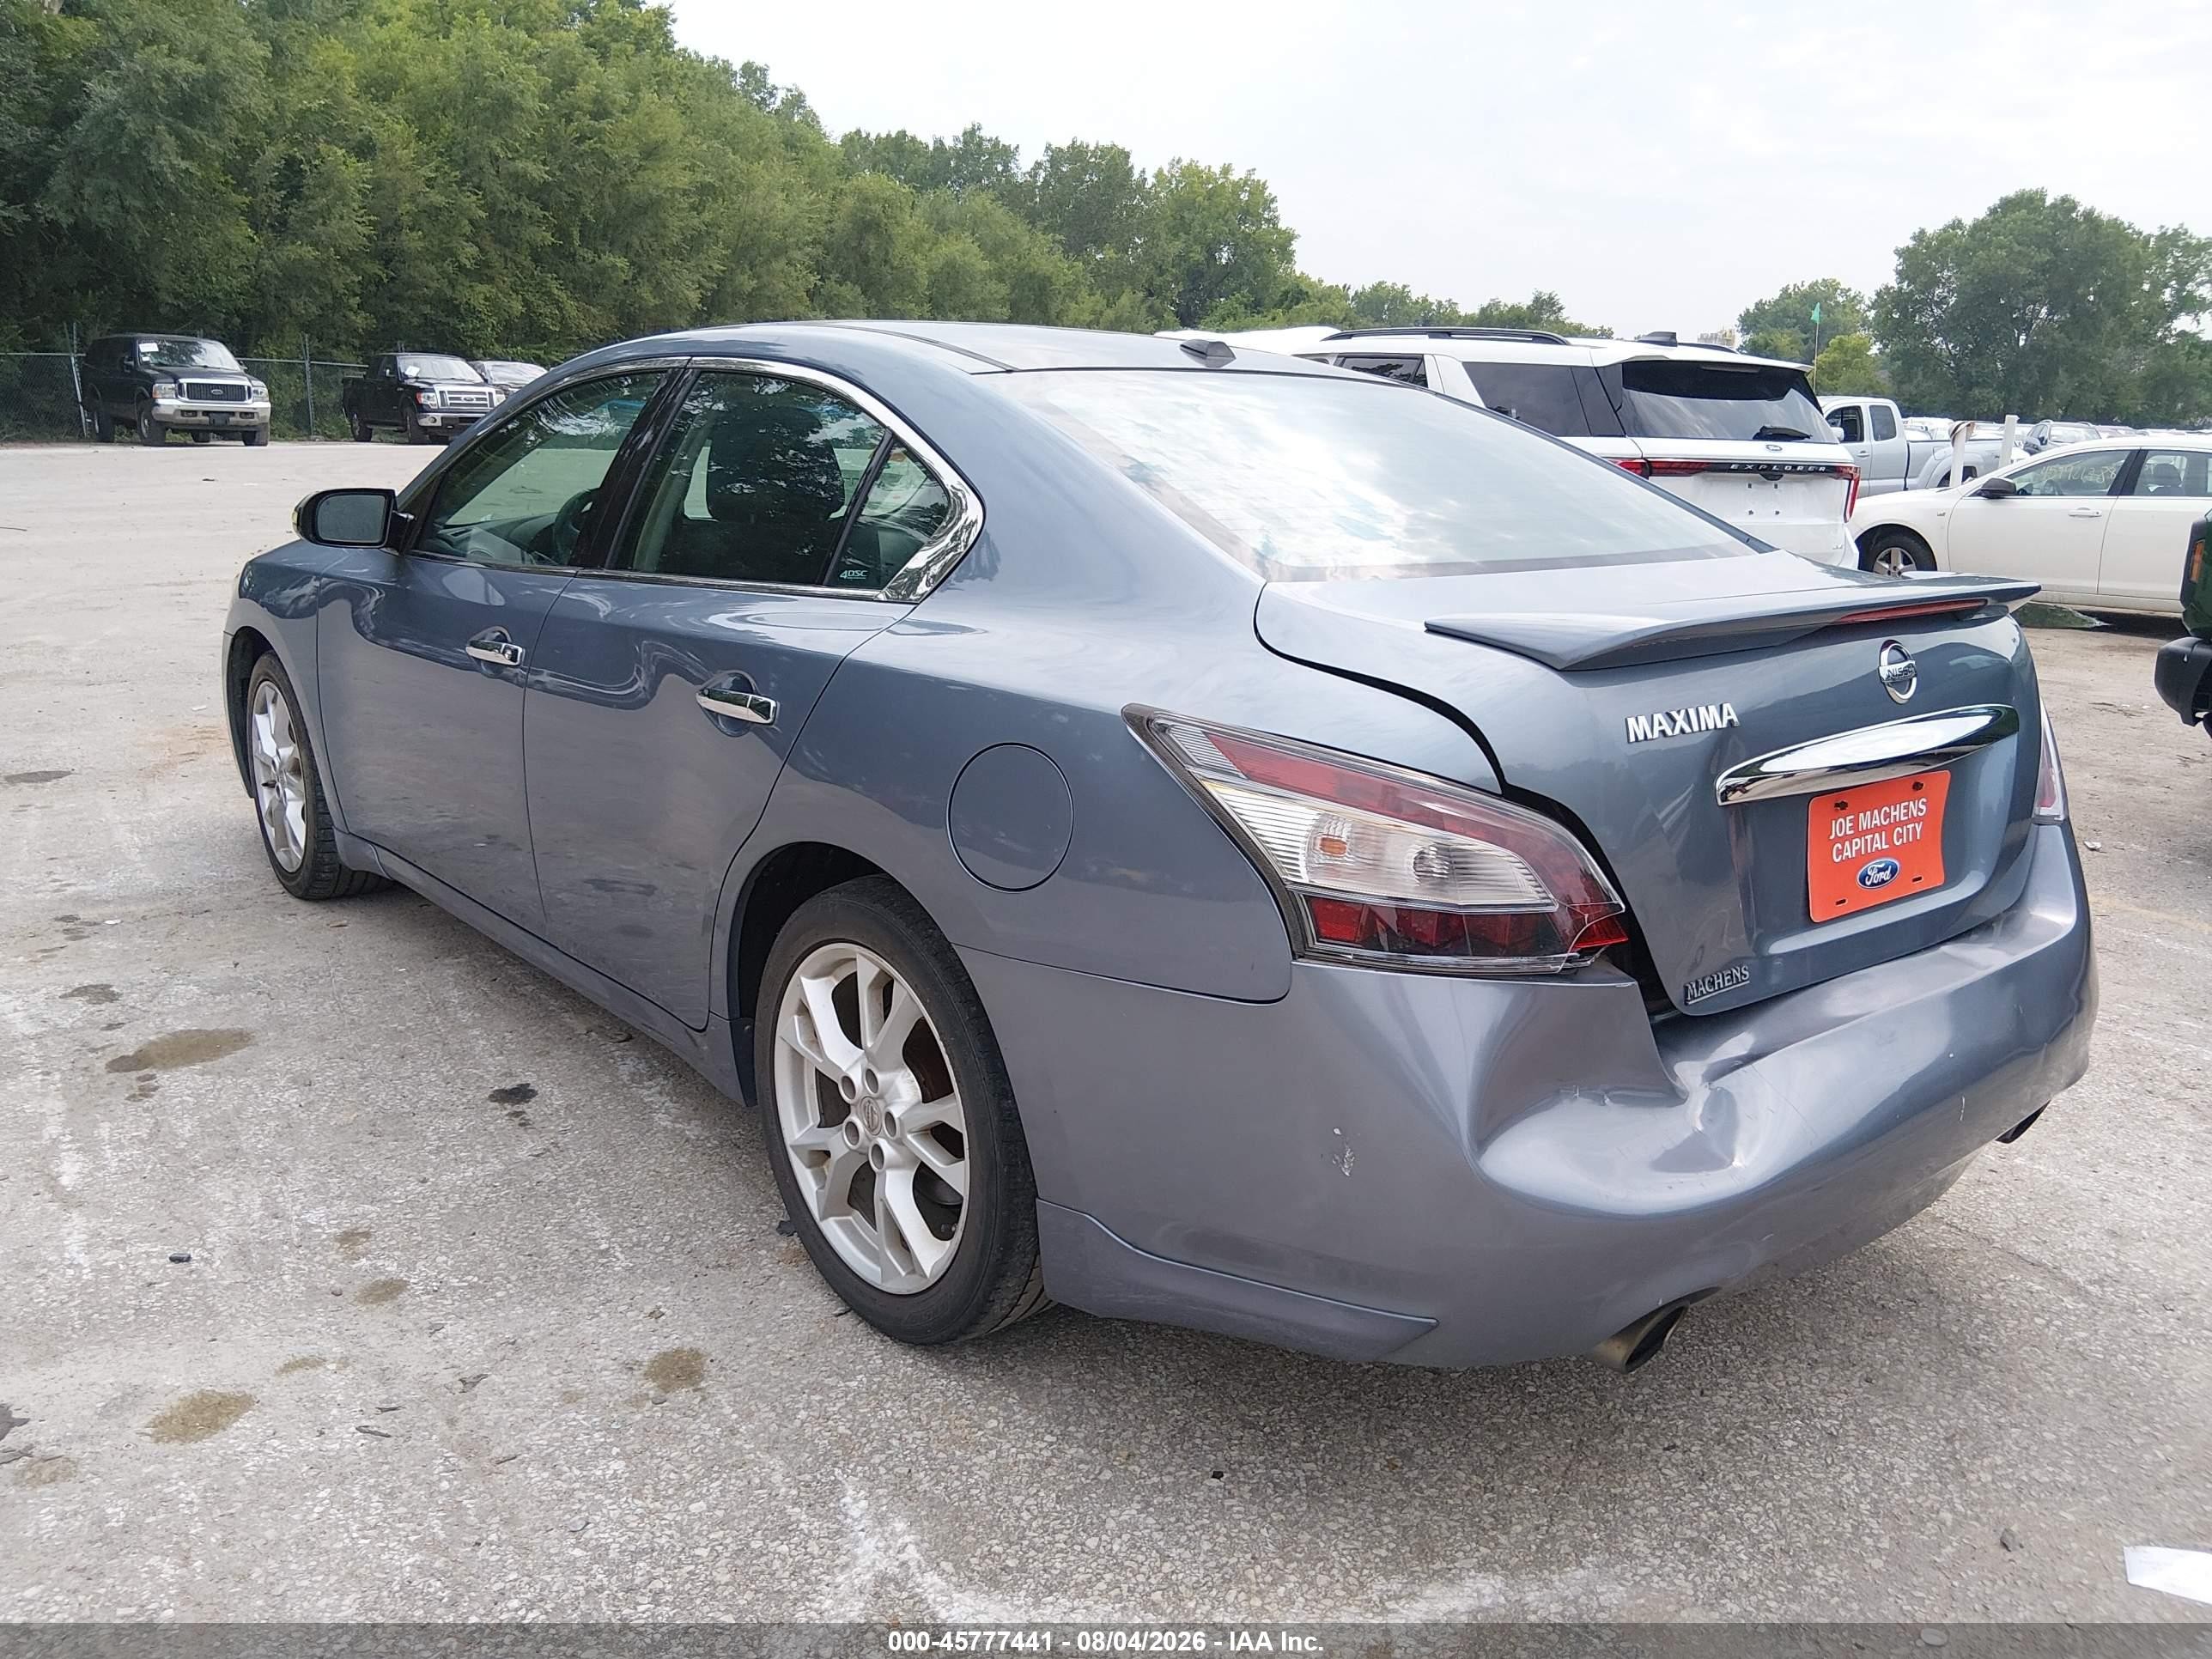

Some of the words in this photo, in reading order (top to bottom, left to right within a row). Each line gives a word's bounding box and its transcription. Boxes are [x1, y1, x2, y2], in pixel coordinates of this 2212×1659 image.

[1729, 464, 1826, 472] EXPLORER
[839, 569, 868, 580] 4DSC
[1626, 702, 1741, 744] MAXIMA
[1829, 815, 1855, 840] JOE
[1858, 798, 1927, 832] MACHENS
[1832, 831, 1889, 863] CAPITAL
[1893, 822, 1923, 846] CITY
[1865, 863, 1892, 886] Ford
[1685, 965, 1750, 1000] MACHENS
